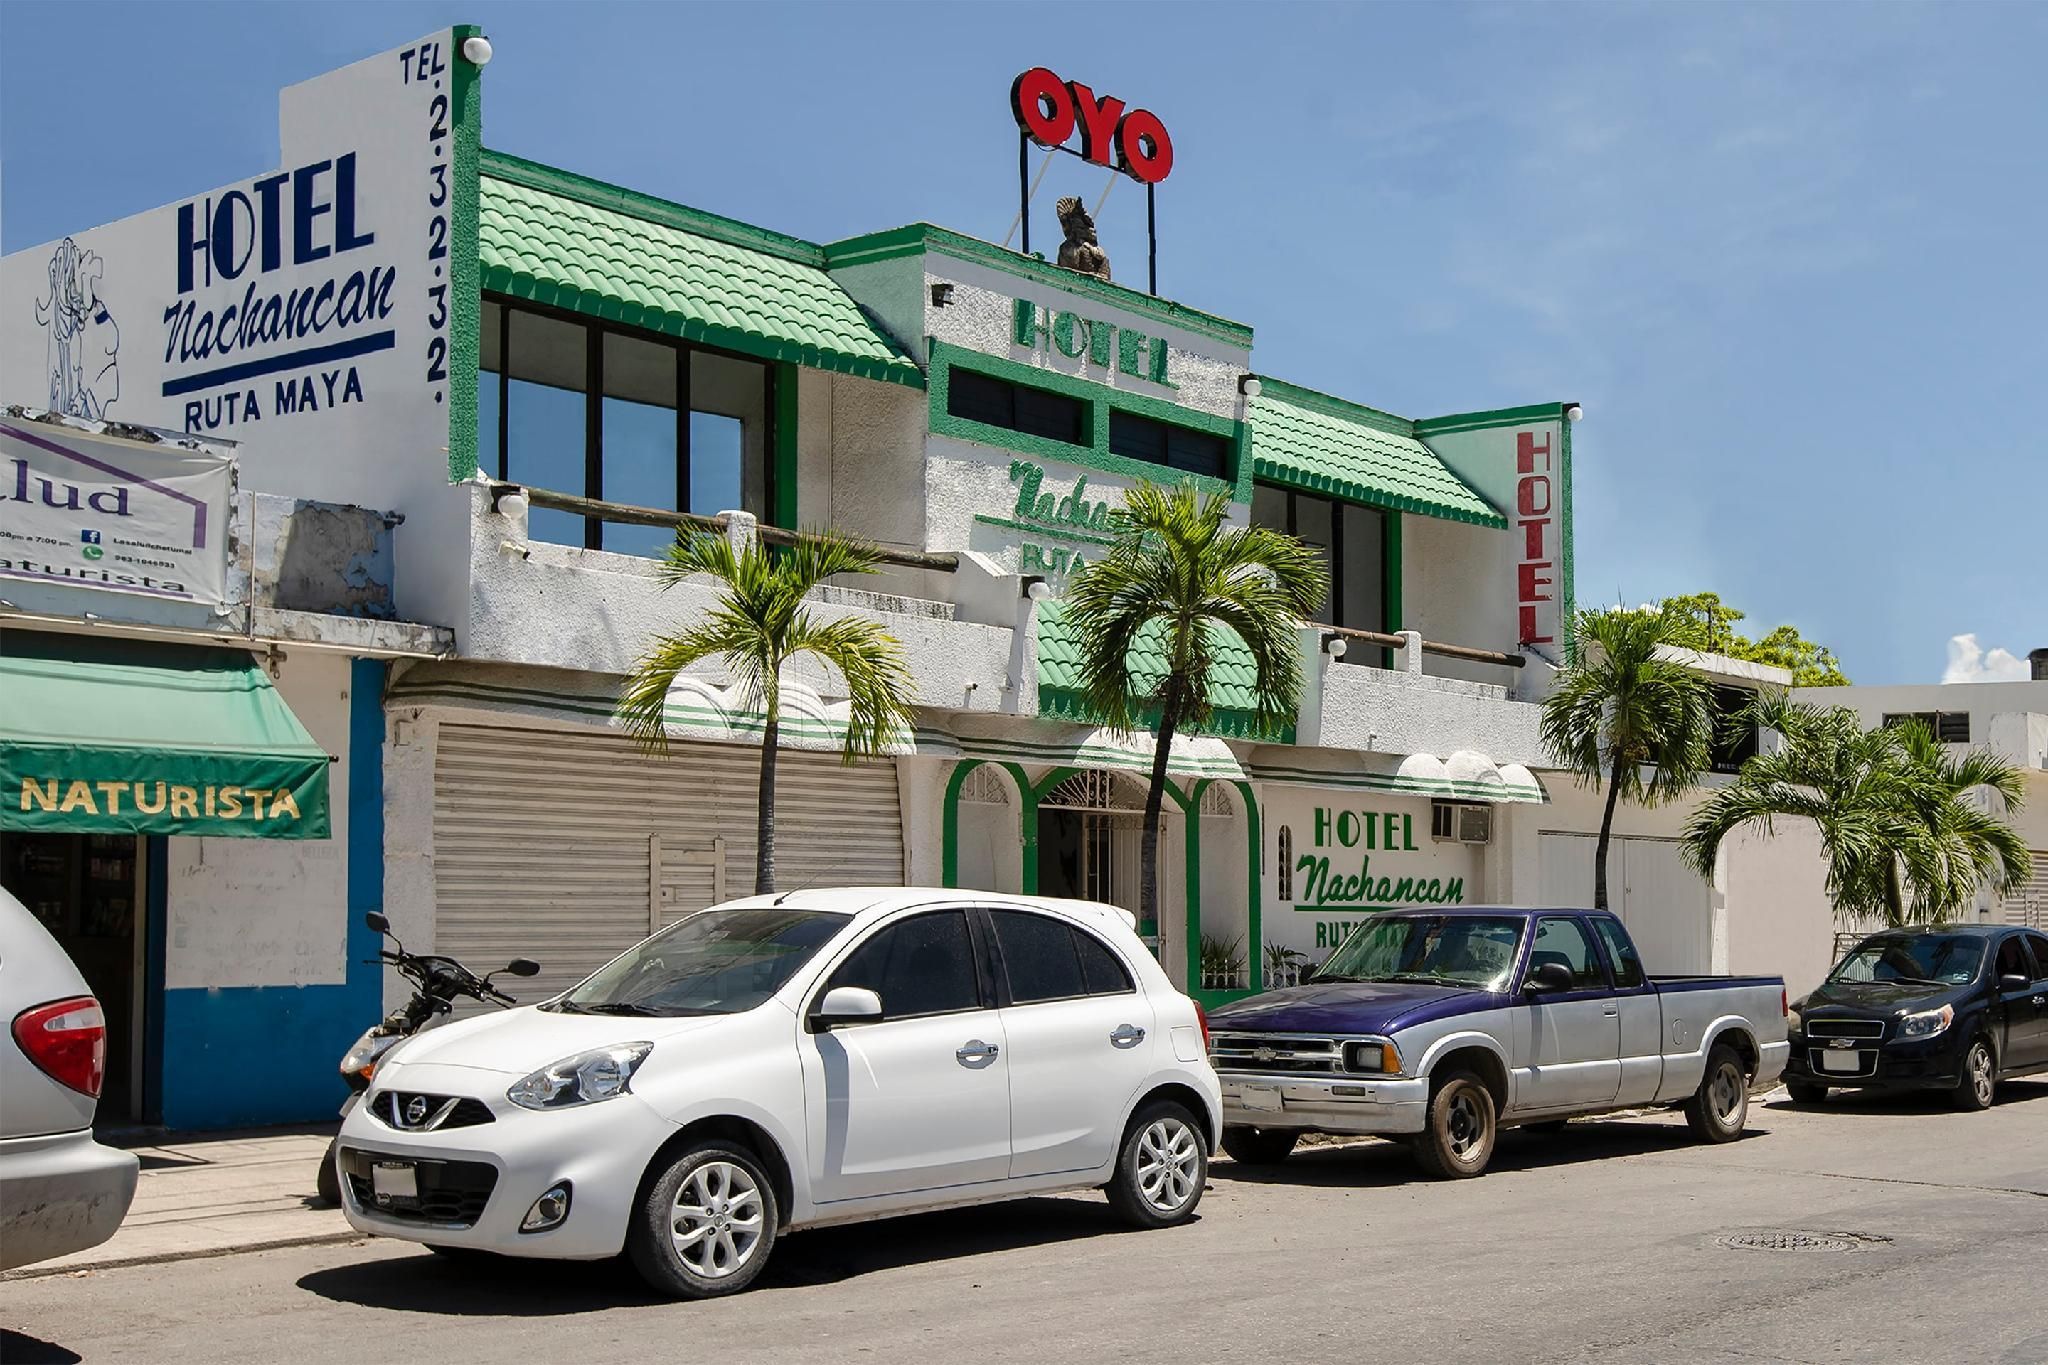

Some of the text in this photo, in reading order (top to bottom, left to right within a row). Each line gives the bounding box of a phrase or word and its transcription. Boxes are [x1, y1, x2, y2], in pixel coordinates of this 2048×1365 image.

[1010, 67, 1174, 185] OYO
[178, 151, 374, 294] HOTEL
[164, 266, 395, 363] Nachancan
[1012, 299, 1181, 390] HOTEL
[185, 366, 363, 433] RUTA MAYA
[0, 459, 133, 516] lud
[1009, 458, 1128, 534] Nacha
[1517, 431, 1553, 644] HOTEL
[20, 777, 301, 821] NATURISTA
[1315, 808, 1419, 851] HOTEL
[1296, 854, 1464, 905] Nachancan
[1316, 921, 1360, 948] RUT
